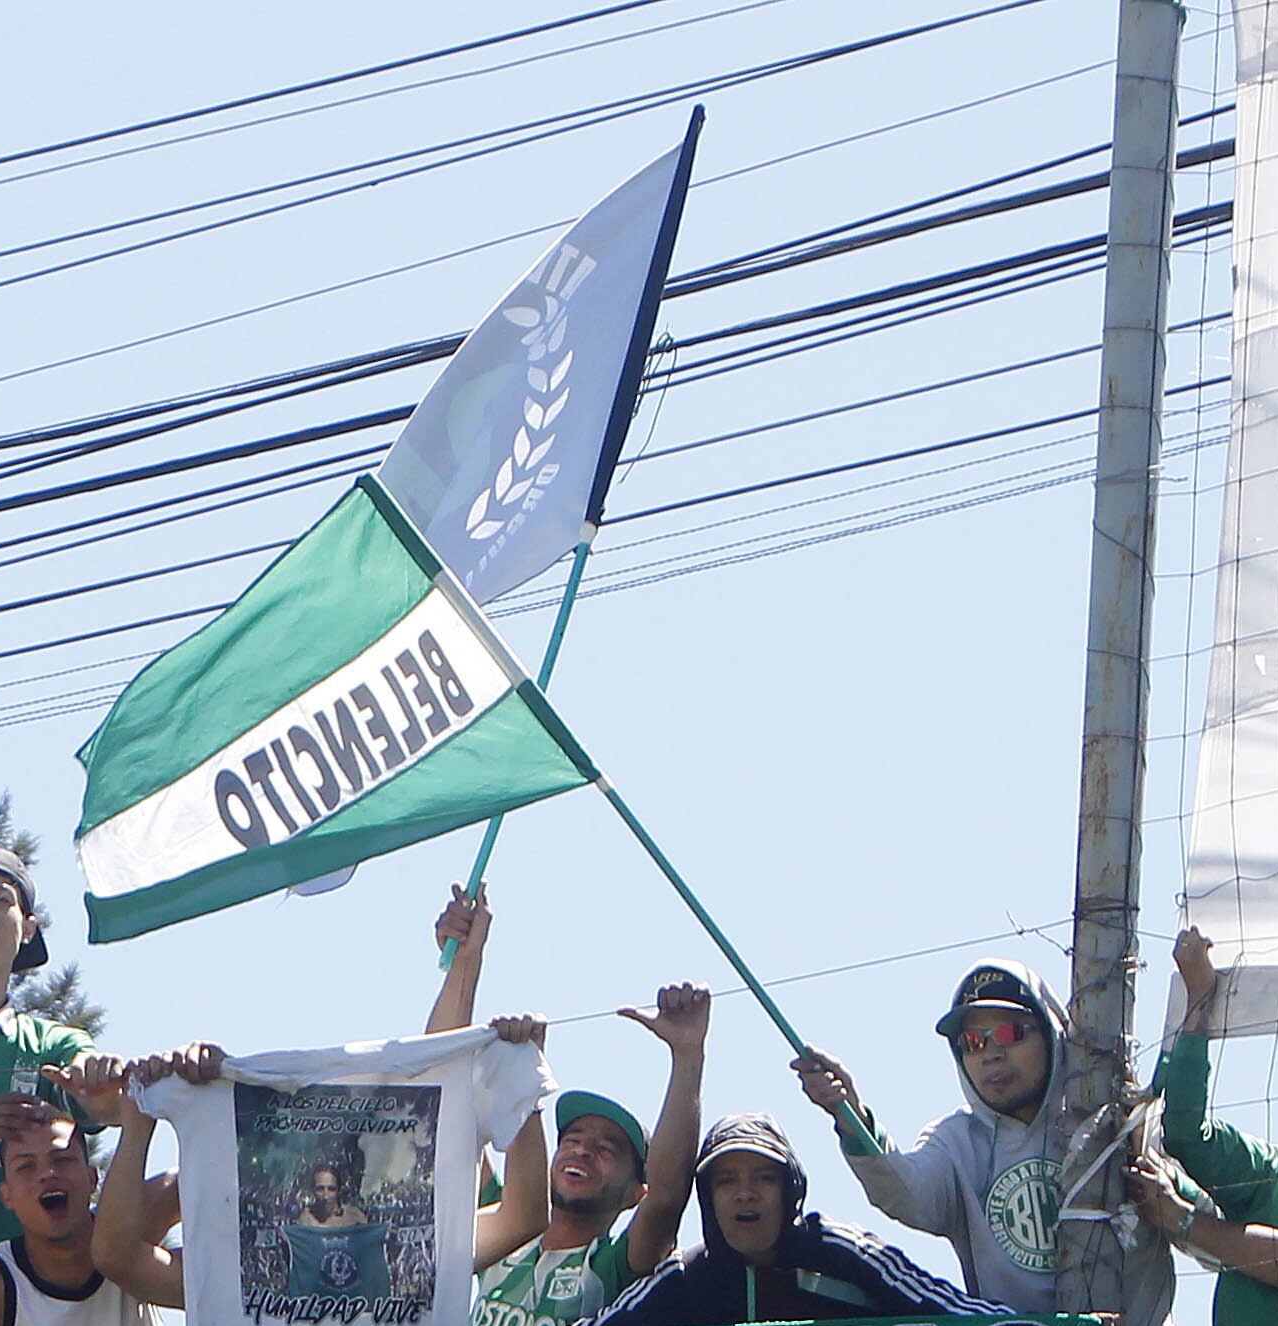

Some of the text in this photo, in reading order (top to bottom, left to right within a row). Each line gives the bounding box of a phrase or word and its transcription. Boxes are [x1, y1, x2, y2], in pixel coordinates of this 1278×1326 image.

[285, 1096, 314, 1109] LOS
[316, 1096, 345, 1111] DEL
[348, 1096, 398, 1112] CIELO
[255, 1114, 419, 1133] PROHIBIDO OLVIDAR
[372, 1296, 428, 1326] VIVE
